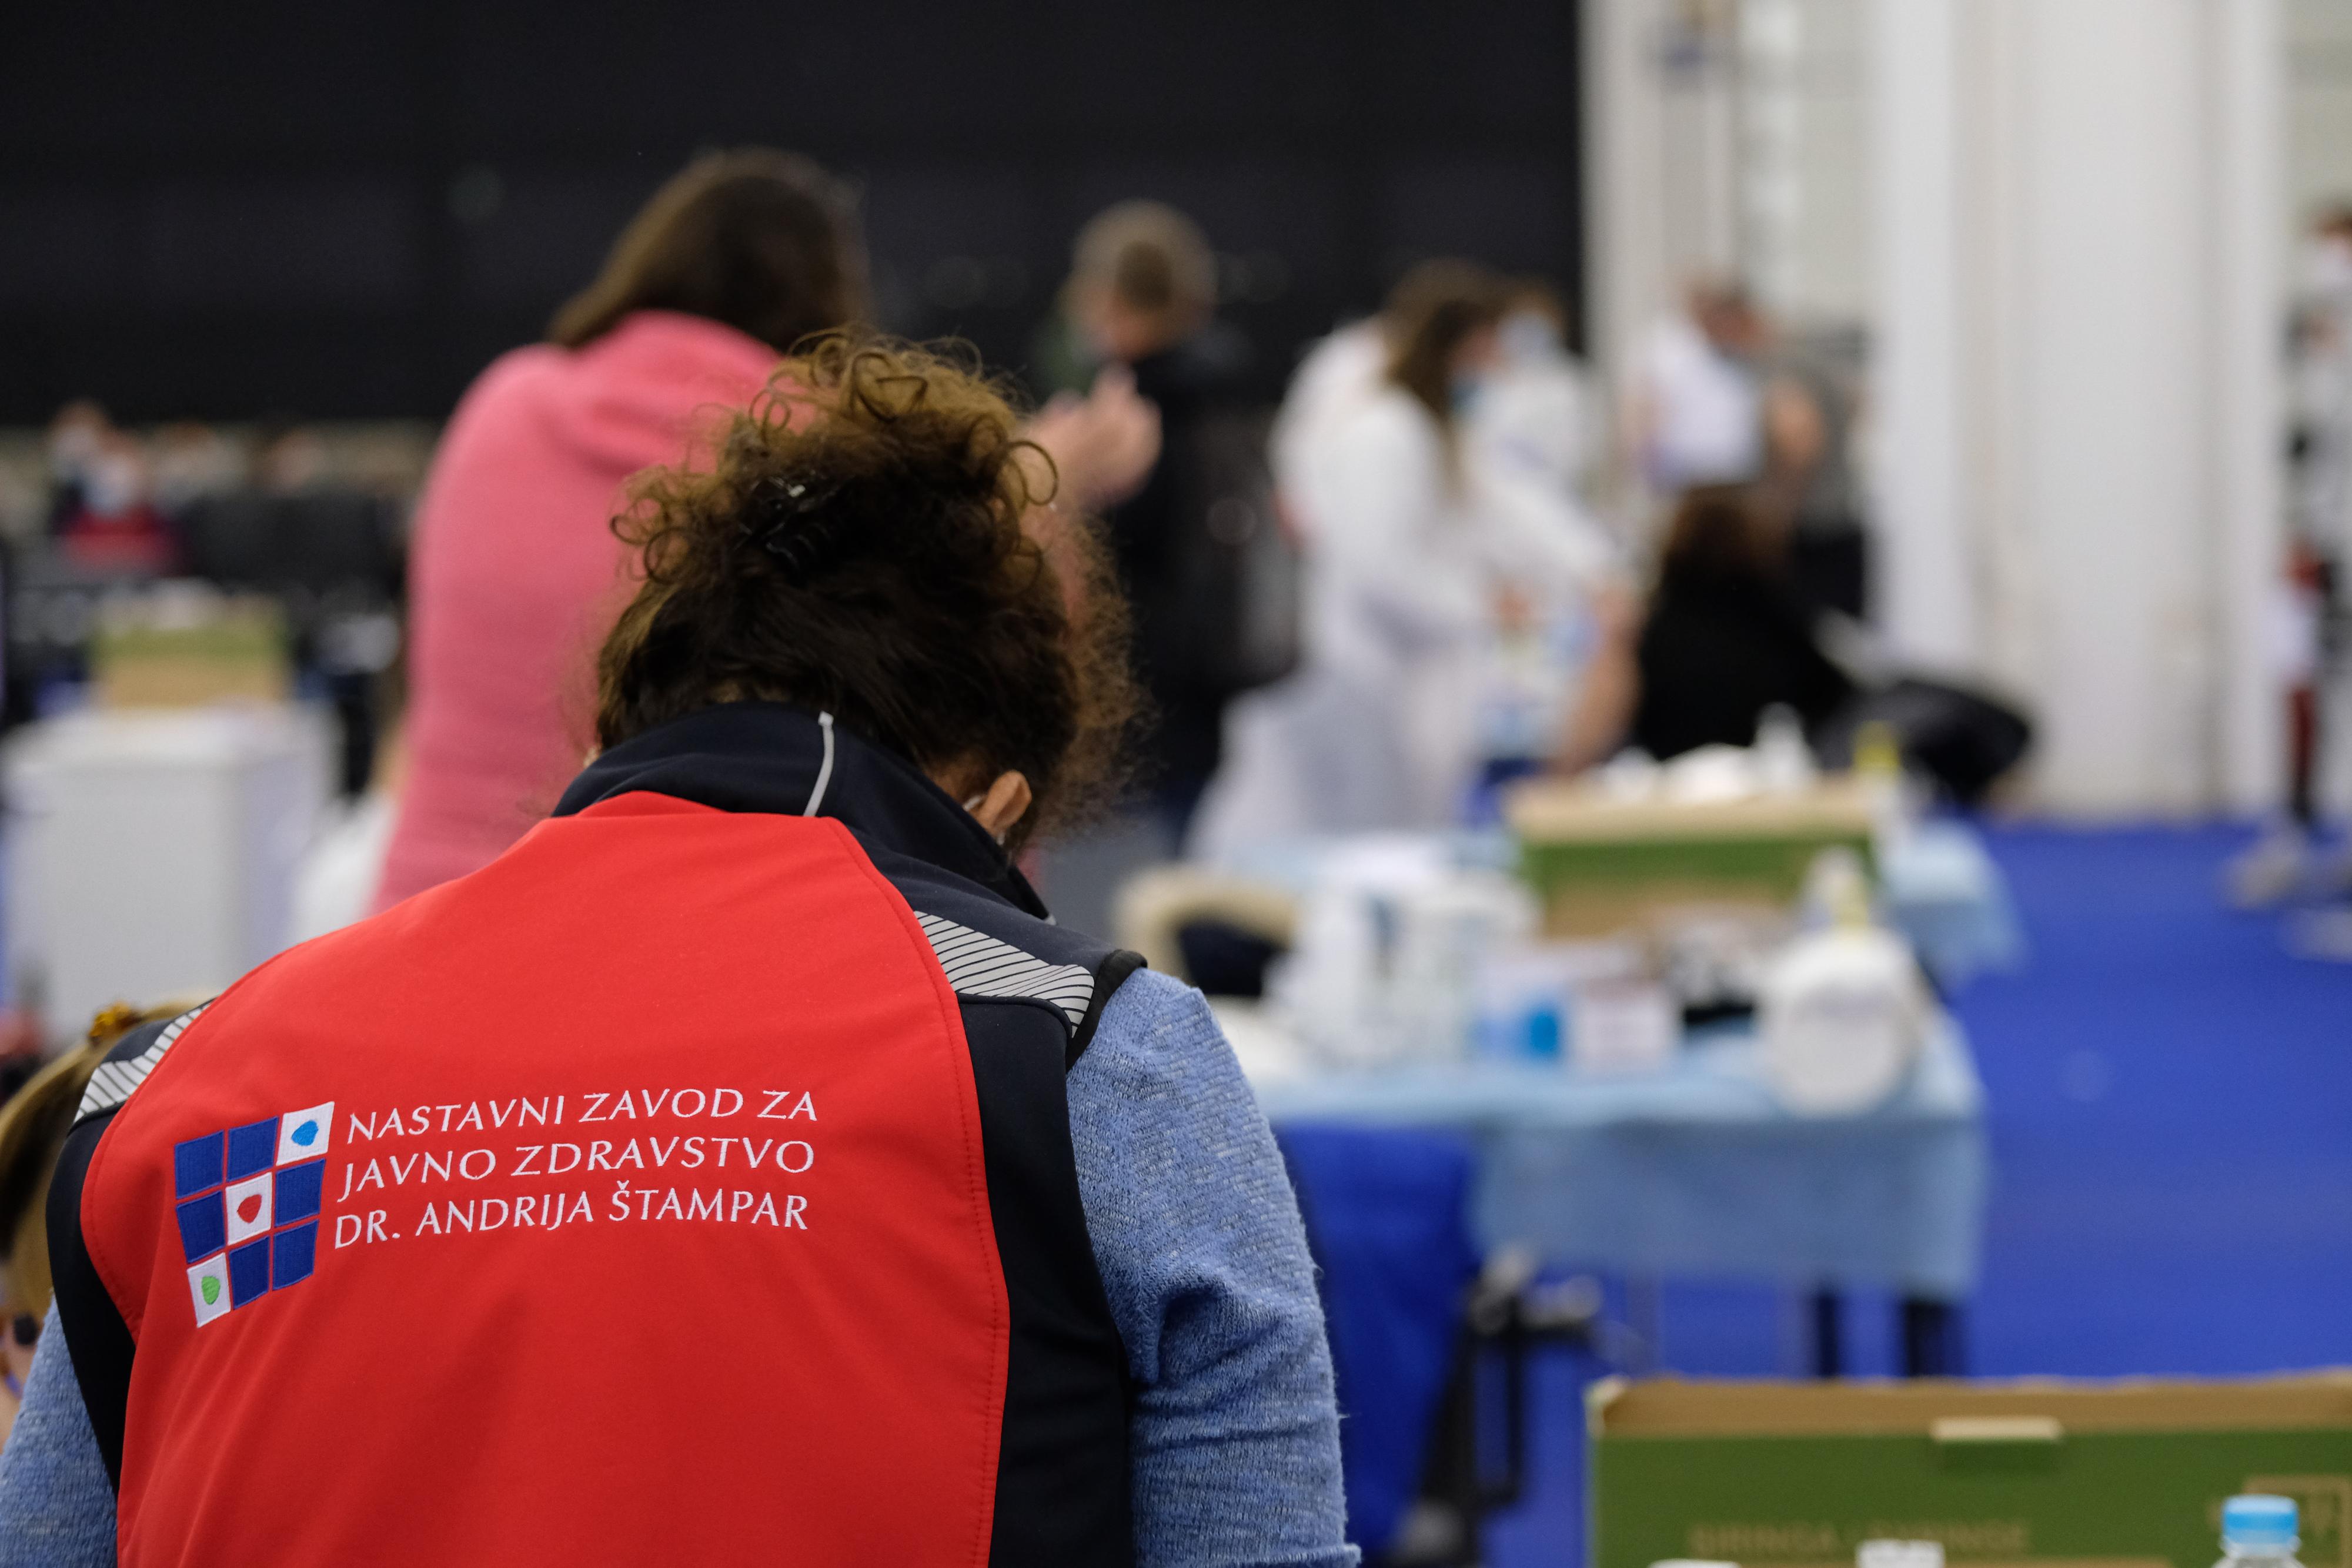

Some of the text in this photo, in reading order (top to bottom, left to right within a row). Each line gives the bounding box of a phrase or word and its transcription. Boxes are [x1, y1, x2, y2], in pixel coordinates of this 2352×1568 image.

[347, 1088, 817, 1144] NASTAVNI ZAVOD ZA
[336, 1136, 814, 1203] JAVNO ZDRAVSTVO
[335, 1179, 808, 1249] DR. ANDRIJA ŠTAMPAR
